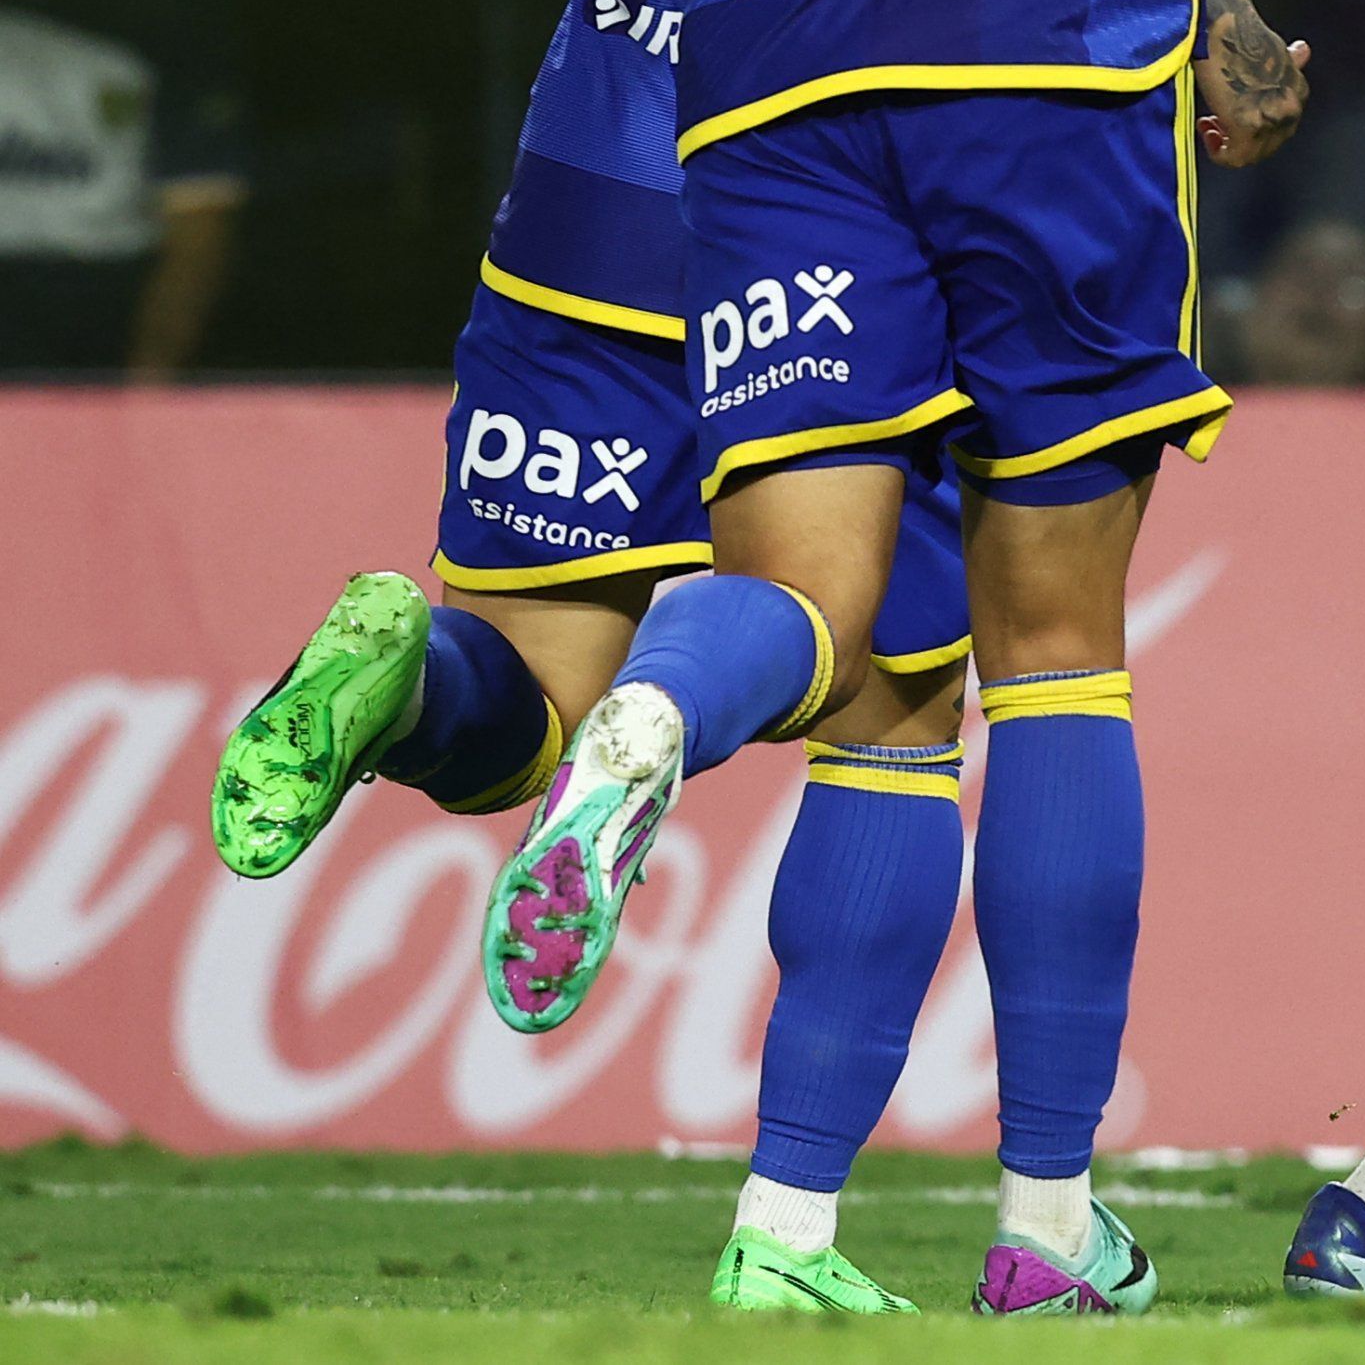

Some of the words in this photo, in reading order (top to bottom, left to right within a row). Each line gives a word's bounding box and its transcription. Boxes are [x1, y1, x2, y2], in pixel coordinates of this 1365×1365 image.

[701, 264, 855, 394] pax
[701, 356, 850, 418] assistance
[460, 409, 649, 512] pax
